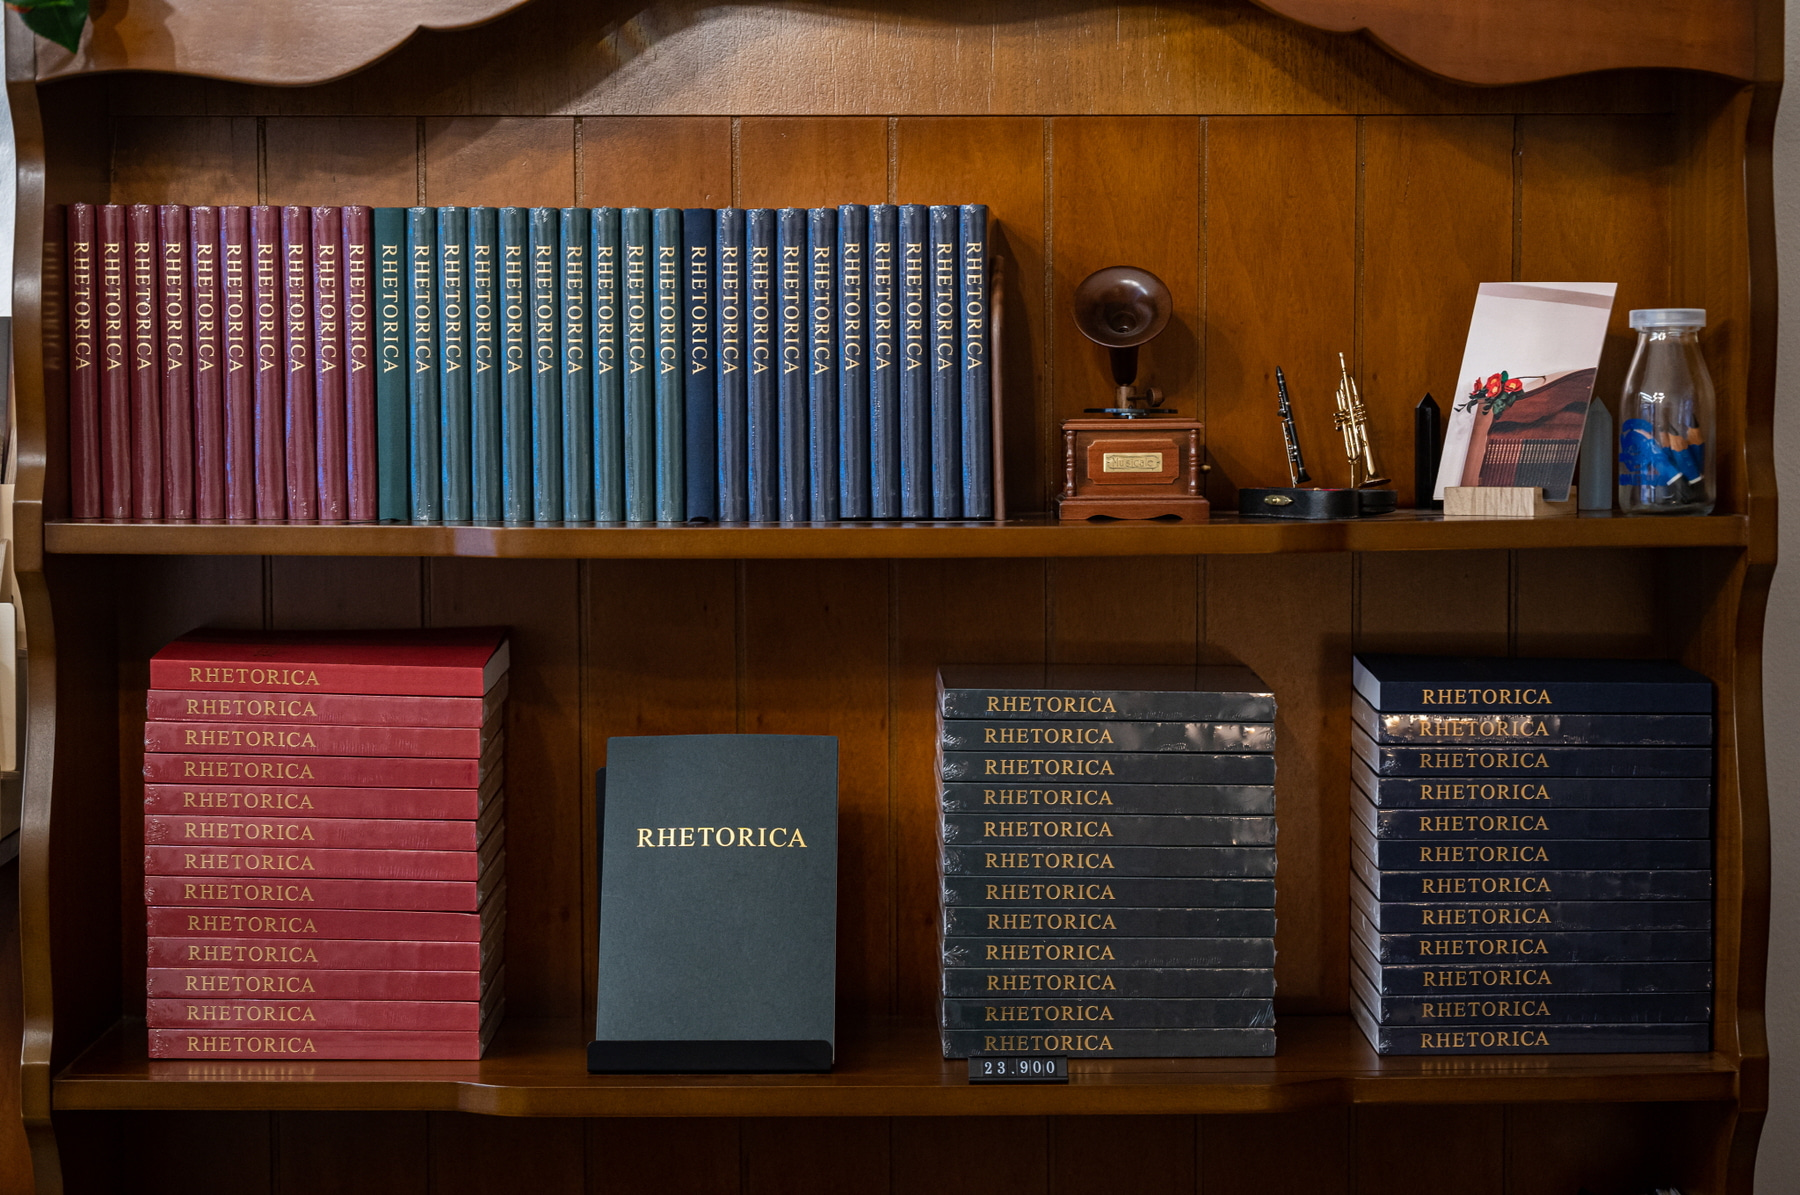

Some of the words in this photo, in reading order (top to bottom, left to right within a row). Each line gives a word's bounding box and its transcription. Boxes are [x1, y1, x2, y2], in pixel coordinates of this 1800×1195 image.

[74, 241, 91, 370] RHETORICA
[104, 242, 122, 371] RHETORICA
[135, 242, 152, 371] RHETORICA
[166, 242, 183, 371] RHETORICA
[197, 244, 215, 372] RHETORICA
[227, 244, 245, 373] RHETORICA
[258, 243, 275, 372] RHETORICA
[288, 244, 306, 373] RHETORICA
[319, 244, 337, 373] RHETORICA
[350, 244, 368, 373] RHETORICA
[383, 244, 399, 373] RHETORICA
[414, 245, 431, 374] RHETORICA
[444, 244, 462, 374] RHETORICA
[475, 245, 492, 373] RHETORICA
[506, 245, 523, 374] RHETORICA
[536, 245, 554, 374] RHETORICA
[568, 245, 583, 375] RHETORICA
[598, 245, 614, 375] RHETORICA
[627, 245, 645, 374] RHETORICA
[659, 245, 676, 375] RHETORICA
[692, 246, 708, 375] RHETORICA
[722, 245, 739, 375] RHETORICA
[753, 246, 770, 375] RHETORICA
[784, 245, 800, 375] RHETORICA
[814, 246, 831, 375] RHETORICA
[845, 242, 861, 371] RHETORICA
[876, 242, 892, 371] RHETORICA
[906, 242, 922, 371] RHETORICA
[937, 242, 953, 372] RHETORICA
[967, 241, 983, 370] RHETORICA
[190, 667, 320, 686] RHETORICA
[987, 697, 1116, 714] RHETORICA
[1422, 689, 1552, 705] RHETORICA
[187, 699, 317, 717] RHETORICA
[984, 728, 1114, 744] RHETORICA
[1420, 721, 1549, 737] RHETORICA
[185, 730, 316, 748] RHETORICA
[184, 761, 314, 779] RHETORICA
[985, 759, 1114, 776] RHETORICA
[1419, 753, 1549, 769] RHETORICA
[184, 792, 314, 809] RHETORICA
[984, 790, 1113, 806] RHETORICA
[1421, 784, 1550, 800] RHETORICA
[185, 823, 314, 841] RHETORICA
[984, 822, 1113, 837] RHETORICA
[1419, 816, 1549, 832] RHETORICA
[636, 827, 807, 848] RHETORICA
[184, 854, 314, 871] RHETORICA
[985, 853, 1114, 869] RHETORICA
[1419, 846, 1549, 862] RHETORICA
[184, 884, 314, 902] RHETORICA
[986, 884, 1115, 900] RHETORICA
[1422, 877, 1551, 894] RHETORICA
[188, 915, 317, 933] RHETORICA
[988, 914, 1116, 930] RHETORICA
[1422, 908, 1551, 924] RHETORICA
[188, 946, 318, 963] RHETORICA
[986, 945, 1115, 960] RHETORICA
[1420, 939, 1549, 955] RHETORICA
[185, 976, 315, 993] RHETORICA
[987, 975, 1116, 991] RHETORICA
[1423, 970, 1552, 986] RHETORICA
[187, 1006, 316, 1021] RHETORICA
[985, 1006, 1114, 1021] RHETORICA
[1422, 1001, 1551, 1018] RHETORICA
[187, 1037, 316, 1053] RHETORICA
[984, 1035, 1113, 1051] RHETORICA
[1421, 1031, 1550, 1048] RHETORICA
[984, 1060, 1055, 1075] 23.900
